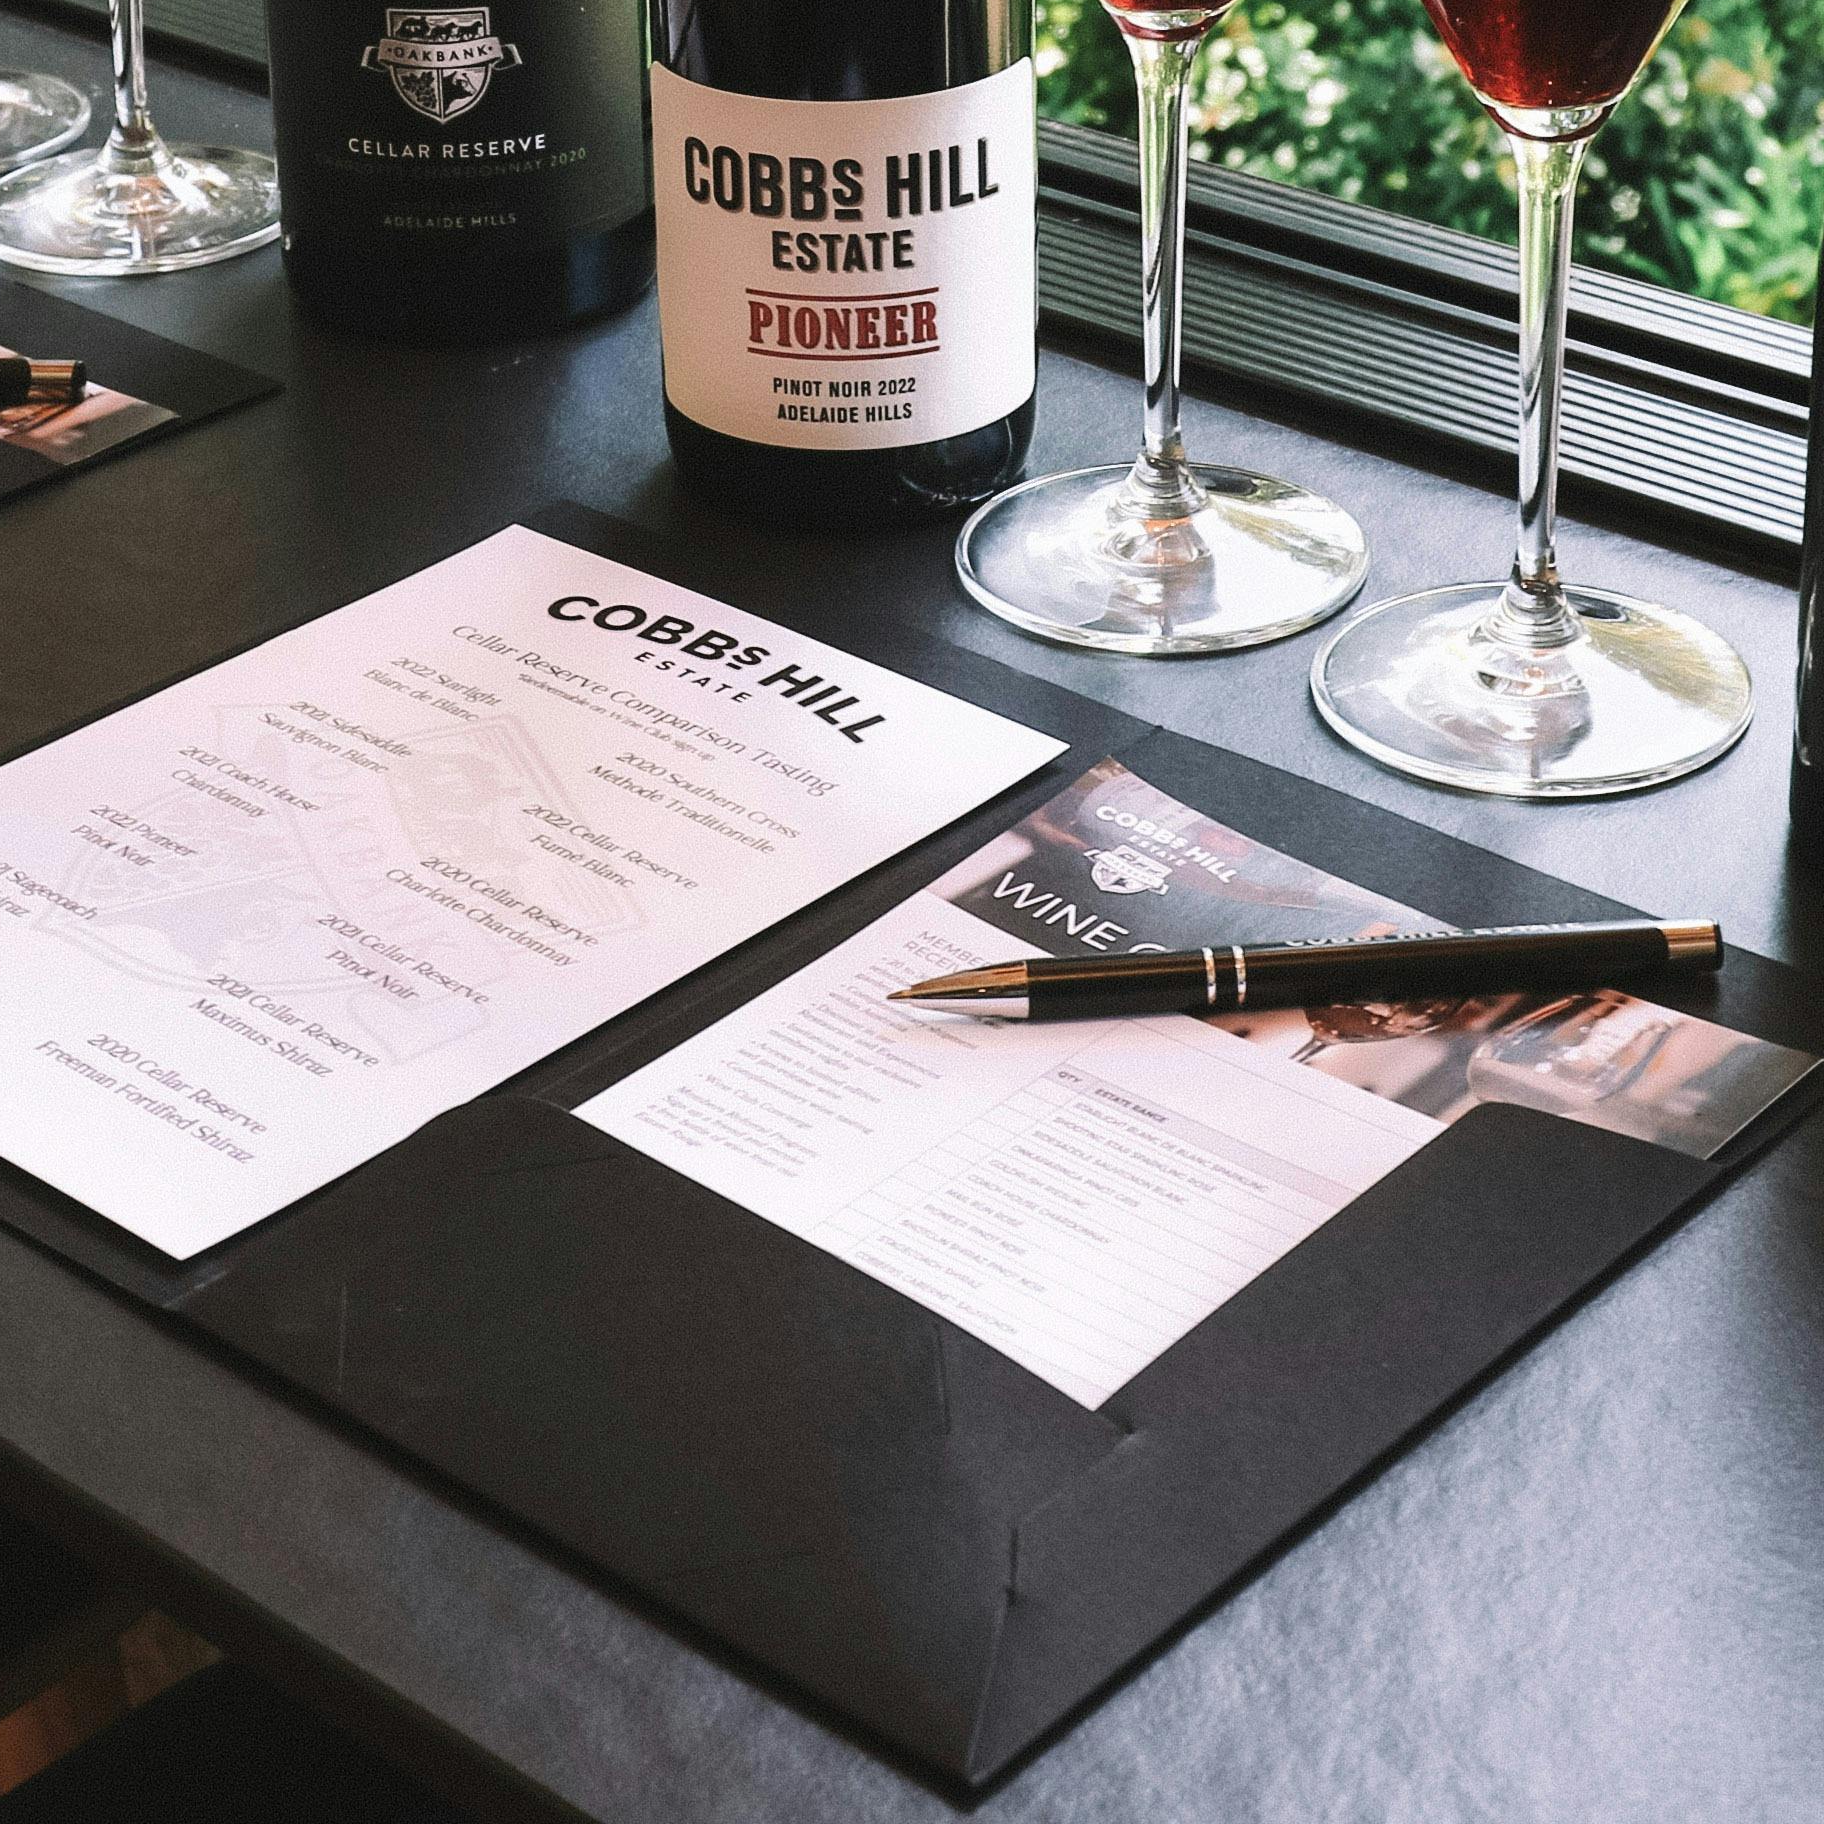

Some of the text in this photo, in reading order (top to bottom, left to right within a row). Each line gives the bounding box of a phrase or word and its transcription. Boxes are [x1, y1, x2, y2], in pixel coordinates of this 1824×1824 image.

[393, 45, 487, 63] OAKBANK
[348, 133, 547, 159] CELLAR RESERVE
[550, 146, 587, 167] 2020
[885, 137, 999, 220] HILL
[382, 212, 517, 229] ADELAIDE HILLS
[772, 229, 915, 272] ESTATE
[747, 300, 939, 350] PIONEER
[772, 377, 916, 398] PINOT NOIR 2022
[777, 402, 913, 424] ADELAIDE HILLS
[362, 668, 480, 722] Blanc de Blanc
[390, 657, 503, 707] 2022 Starlight
[634, 652, 752, 703] ESTATE
[451, 625, 840, 797] Cellar Reserve Comparison Tasting
[757, 663, 886, 745] HILL
[263, 712, 390, 773] Sauvignon Blanc
[332, 717, 412, 757] Sidesaddle
[170, 769, 266, 818] Chardonnay
[216, 762, 269, 790] Coach
[265, 784, 321, 812] House
[615, 752, 801, 839] 2020 Southern Cross
[70, 824, 155, 867] Pinot Noir
[89, 805, 199, 857] 2022 Pioneer
[521, 805, 699, 889] 2022 Cellar Reserve
[664, 798, 776, 854] Traditionelle
[581, 858, 635, 888] Blanc
[1185, 846, 1238, 884] HILL
[5, 870, 98, 921] Stagecoach
[385, 868, 574, 967] Charlotte Chardonnay
[419, 857, 598, 946] 2020 Cellar Reserve
[992, 871, 1129, 951] WINE
[325, 949, 419, 1000] Pinot Noir
[358, 934, 416, 965] Cellar
[410, 960, 490, 1005] Reserve
[918, 930, 991, 971] MEMBE
[188, 997, 334, 1078] Maximus Shiraz
[247, 993, 306, 1027] Cellar
[300, 1022, 380, 1066] Reserve
[34, 1039, 255, 1164] Freeman Fortified Shiraz
[86, 1033, 267, 1134] 2020 Cellar Reserve
[1057, 1070, 1083, 1084] QTY
[1094, 1088, 1168, 1124] ESTATE RANGE
